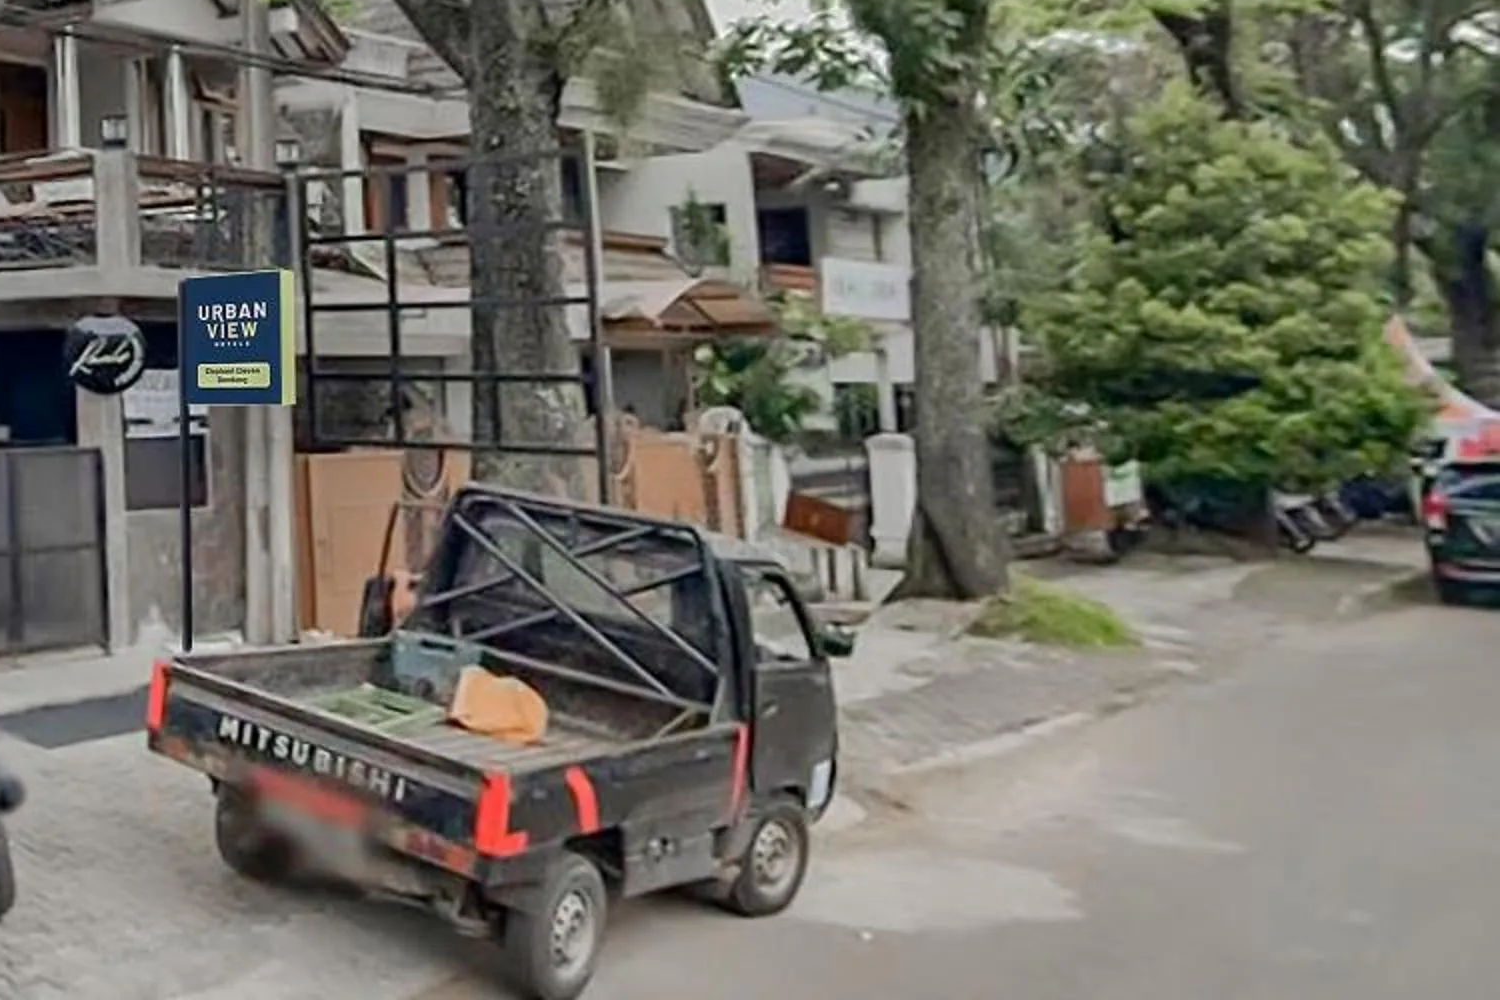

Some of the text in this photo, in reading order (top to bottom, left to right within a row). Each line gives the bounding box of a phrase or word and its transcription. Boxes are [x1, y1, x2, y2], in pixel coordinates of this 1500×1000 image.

[198, 302, 267, 321] URBAN
[206, 321, 258, 339] VIEW
[218, 714, 406, 801] MITSUBISHI
